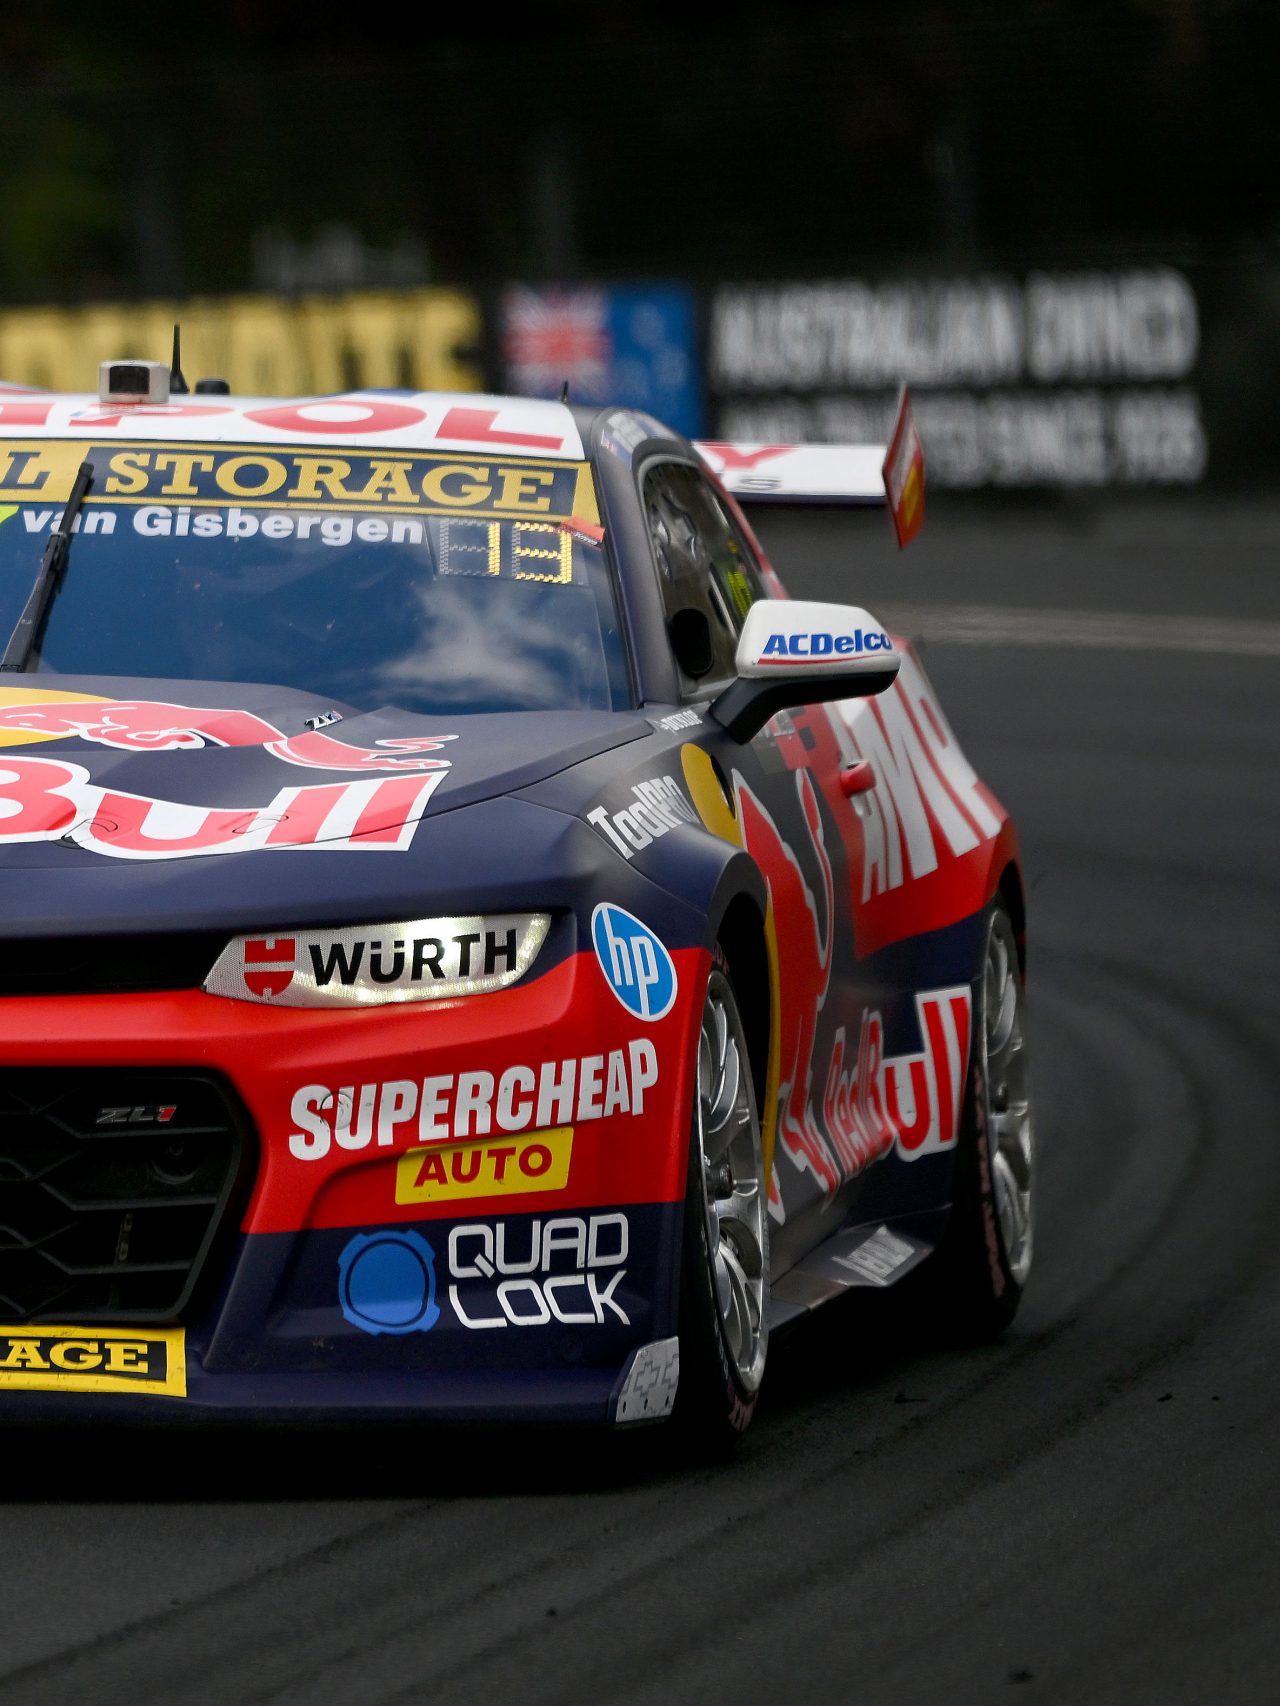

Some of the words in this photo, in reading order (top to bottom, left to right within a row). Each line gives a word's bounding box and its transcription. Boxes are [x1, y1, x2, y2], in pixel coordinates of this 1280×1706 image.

[106, 451, 555, 513] STORAGE
[132, 506, 424, 546] Gisbergen
[762, 628, 893, 656] ACDelco
[600, 905, 662, 1018] hp
[288, 1039, 659, 1162] SUPERCHEAP
[413, 1144, 553, 1188] AUTO
[447, 1213, 629, 1279] QUAD
[447, 1270, 631, 1329] LOCK
